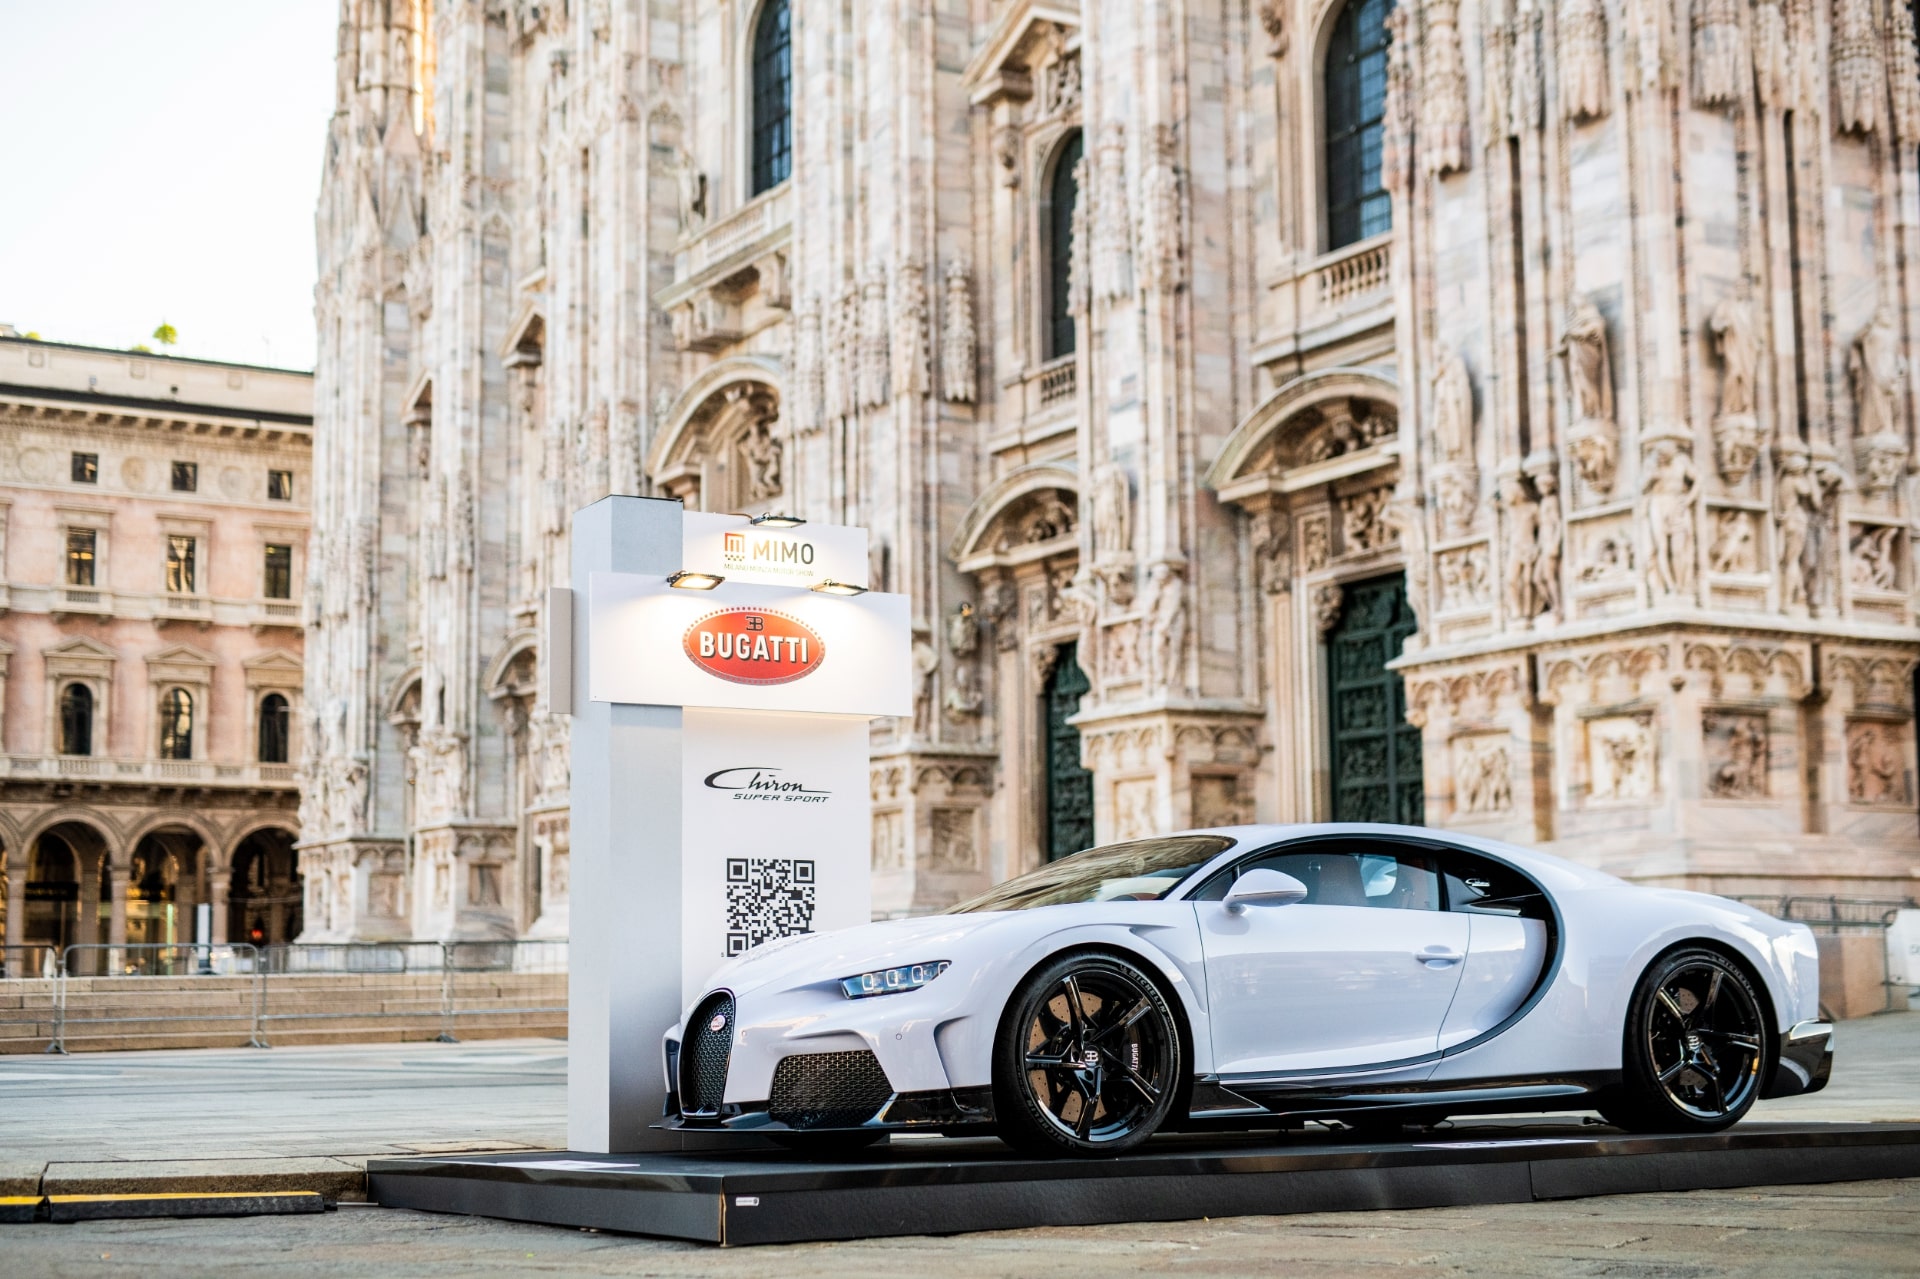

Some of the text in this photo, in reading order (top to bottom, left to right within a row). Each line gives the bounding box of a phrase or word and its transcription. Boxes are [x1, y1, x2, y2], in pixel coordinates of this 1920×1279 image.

[753, 540, 814, 565] MIMO
[700, 631, 808, 664] BUGATTI
[704, 766, 832, 793] Chiron
[732, 793, 829, 803] SUPER SPORT
[1129, 971, 1168, 1014] MICHELIN
